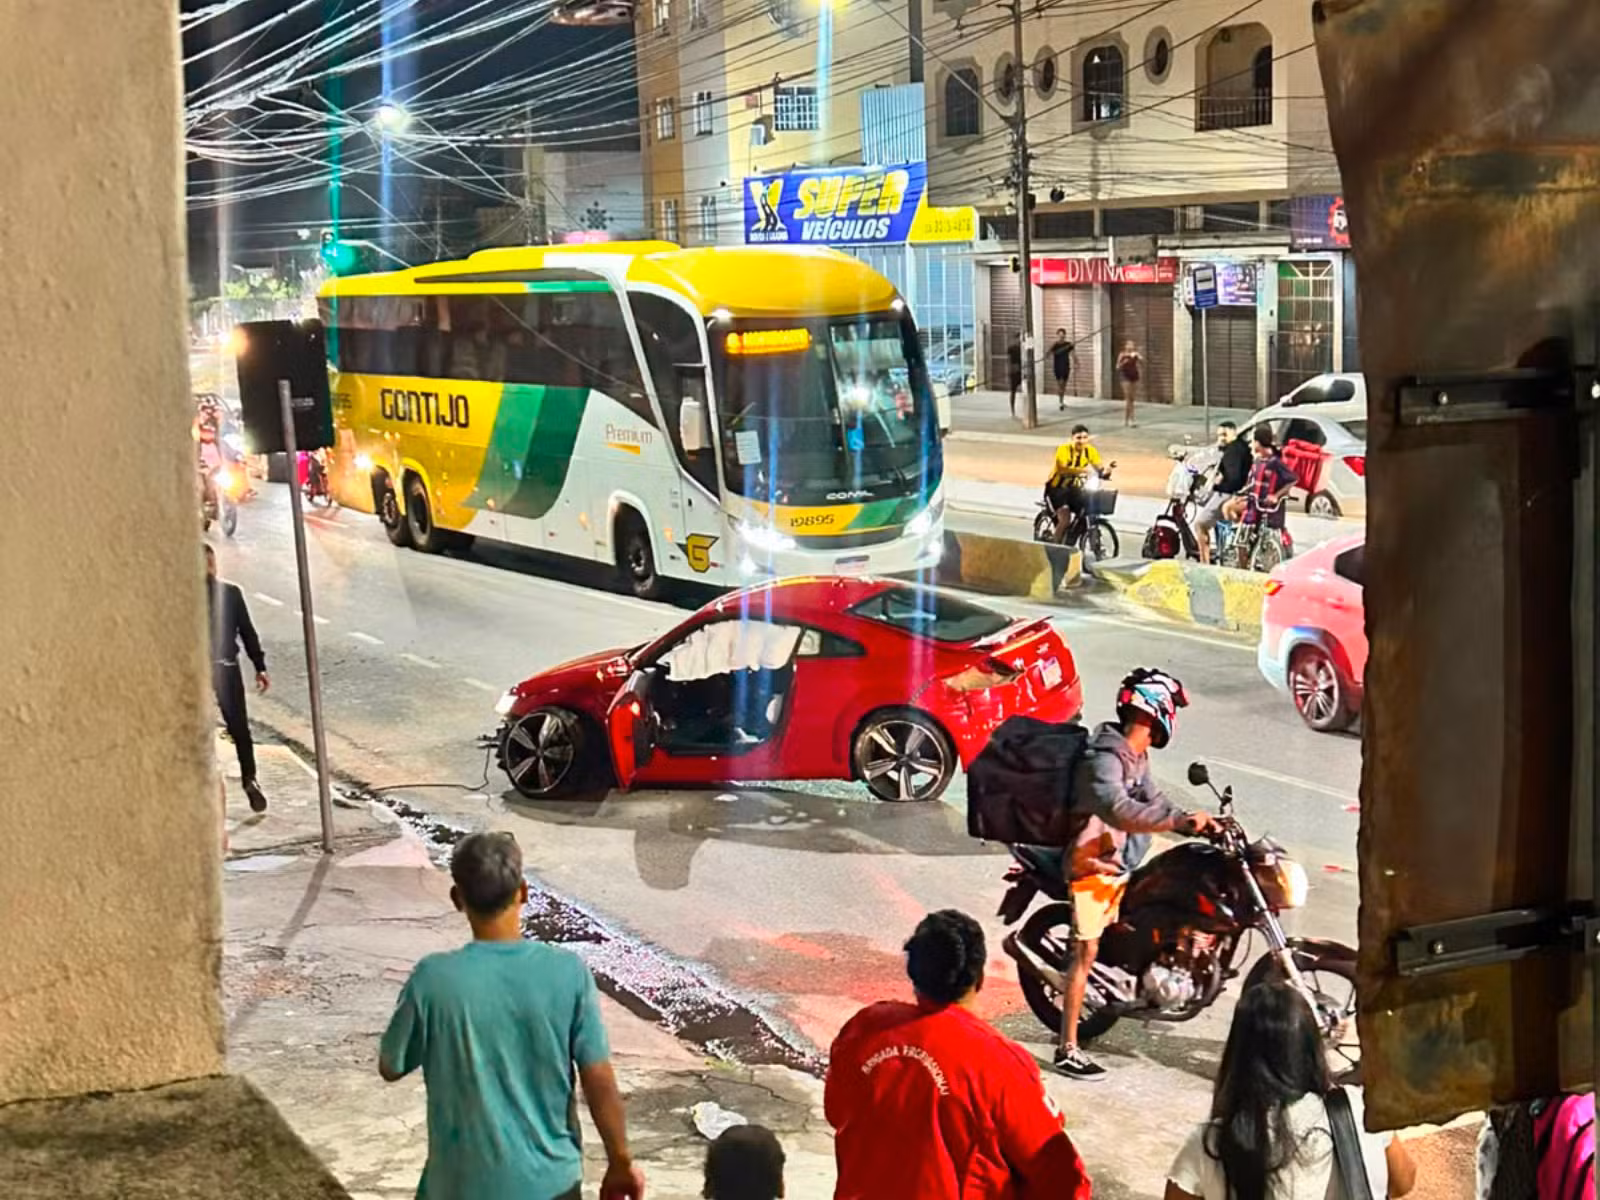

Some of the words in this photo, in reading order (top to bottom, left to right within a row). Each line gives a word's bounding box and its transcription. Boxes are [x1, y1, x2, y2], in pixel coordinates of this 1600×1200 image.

[793, 169, 909, 219] SUPER
[801, 217, 890, 241] VEÍCULOS
[1067, 259, 1125, 283] DIVINA
[380, 388, 469, 429] GONTIJO
[605, 423, 653, 444] Premium
[790, 513, 835, 528] 19895
